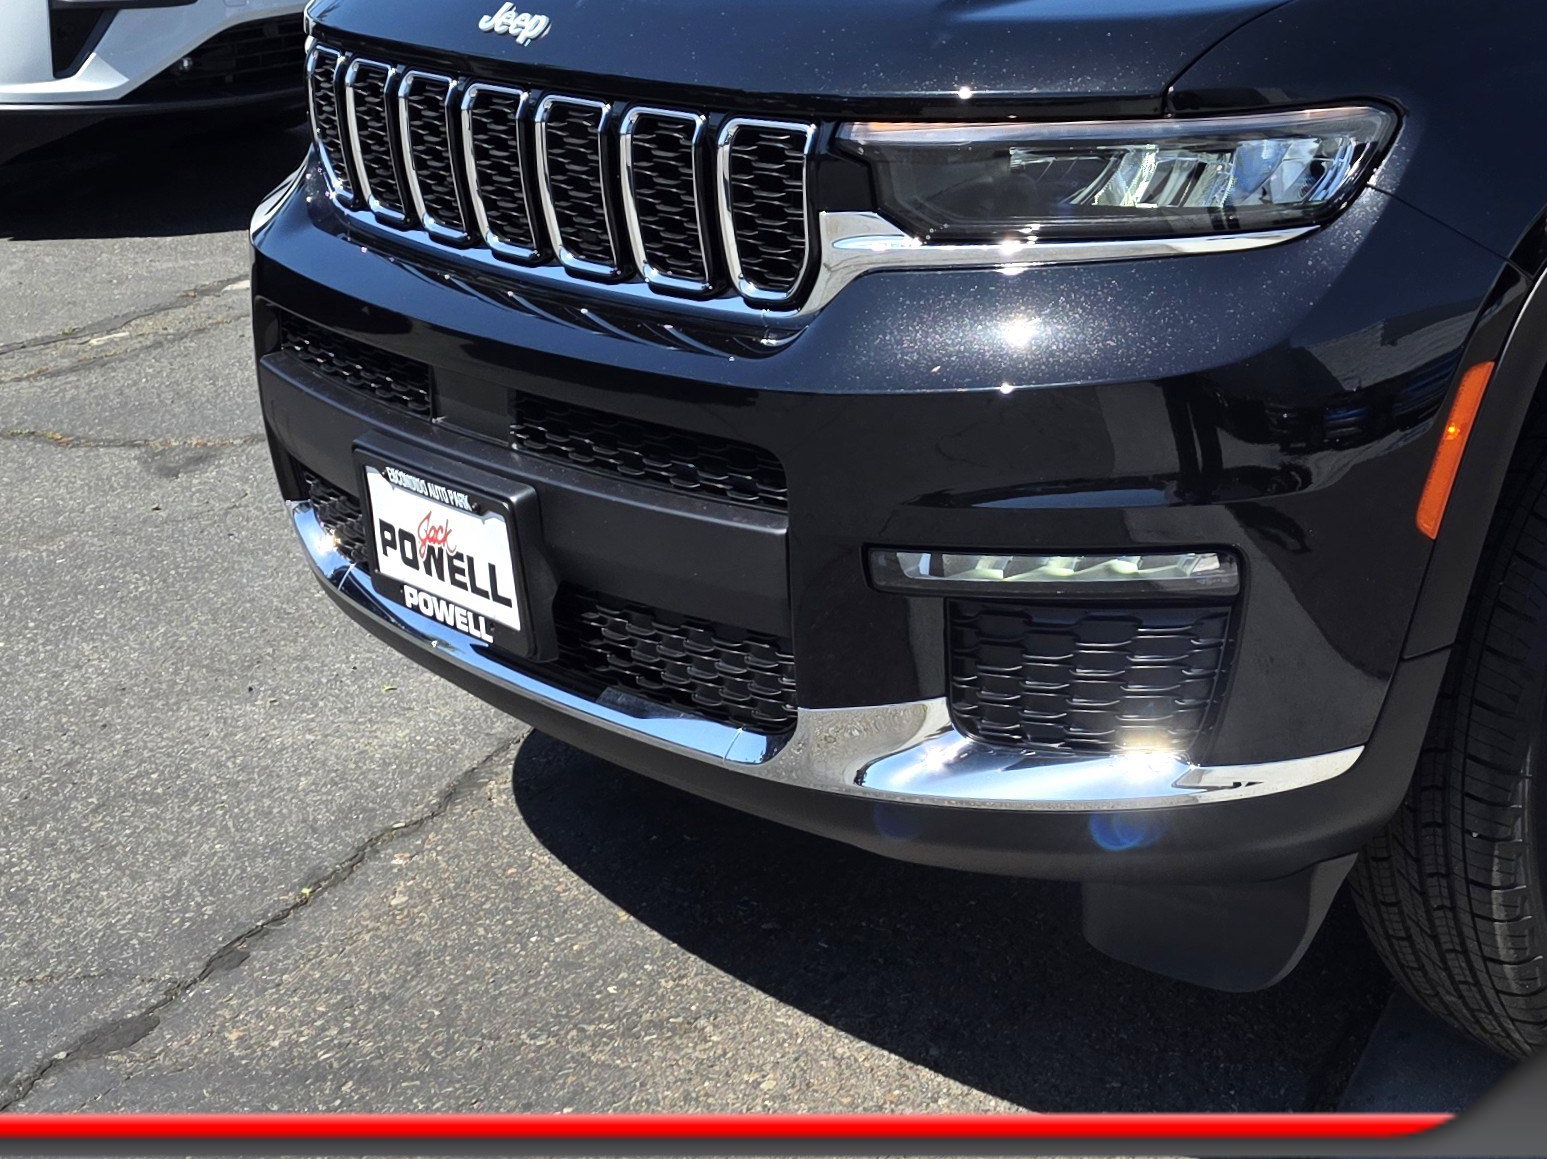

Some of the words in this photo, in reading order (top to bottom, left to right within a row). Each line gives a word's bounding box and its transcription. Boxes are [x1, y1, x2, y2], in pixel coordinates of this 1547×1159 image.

[478, 1, 552, 47] Jeep
[427, 482, 449, 504] AUTO
[447, 489, 473, 512] PARK
[417, 510, 457, 559] Jack
[379, 518, 513, 609] POWELL
[403, 584, 494, 644] POWELL
